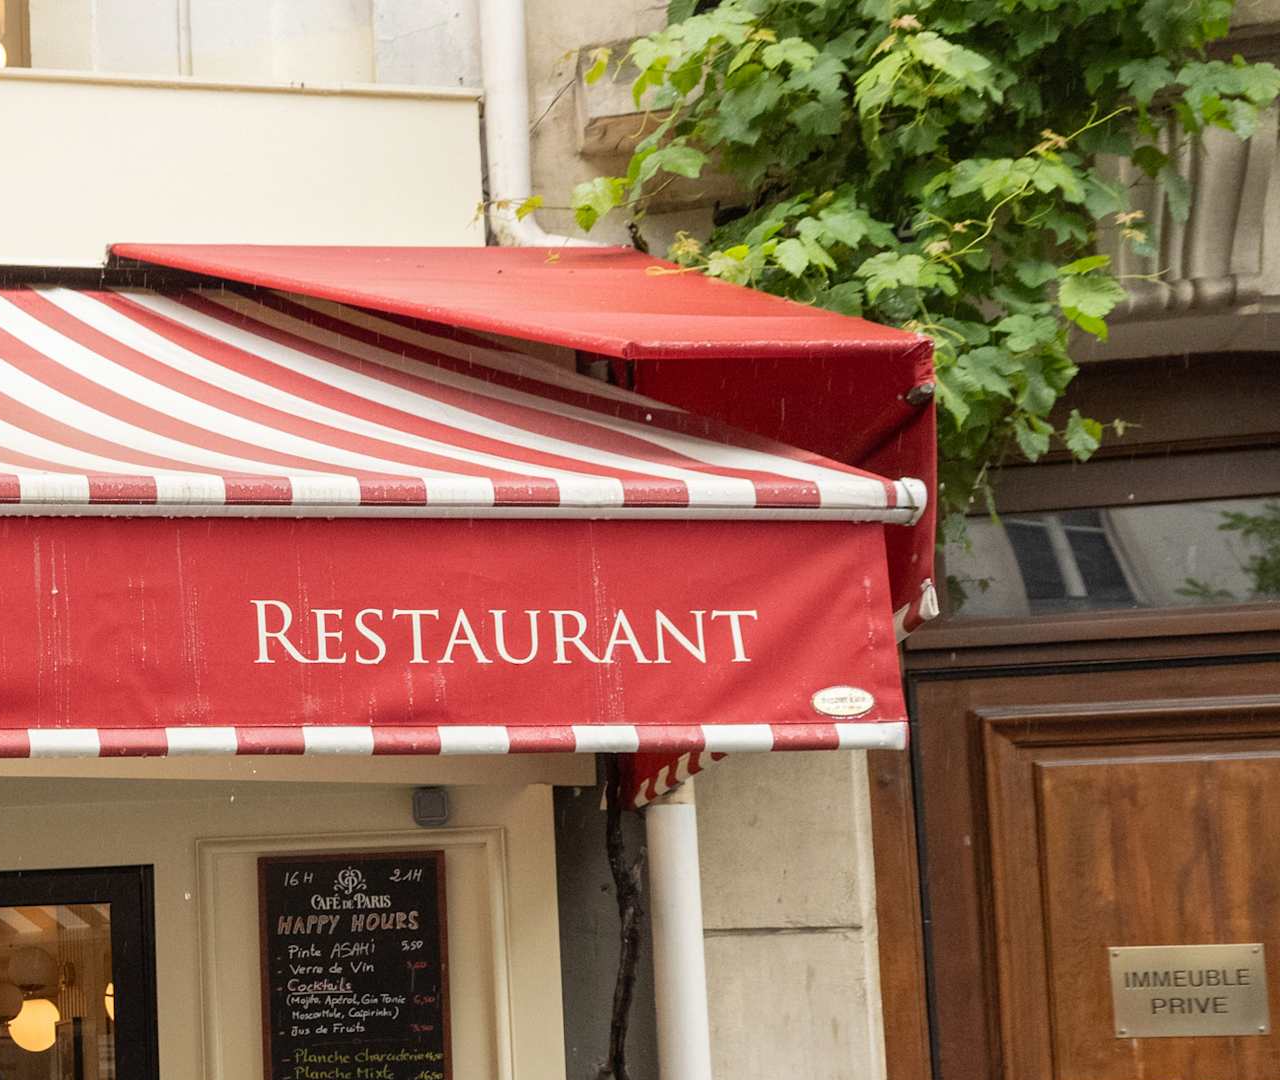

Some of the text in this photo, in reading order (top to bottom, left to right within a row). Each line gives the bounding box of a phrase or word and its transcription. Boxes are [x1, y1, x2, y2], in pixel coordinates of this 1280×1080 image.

[251, 600, 759, 665] RESTAURANT
[277, 910, 420, 935] HAPPY HOURS
[290, 961, 374, 975] Verre de Vin
[287, 977, 352, 992] Cocktails
[1124, 968, 1251, 988] IMMEUBLE
[1151, 996, 1229, 1015] PRIVE
[315, 1024, 328, 1034] de
